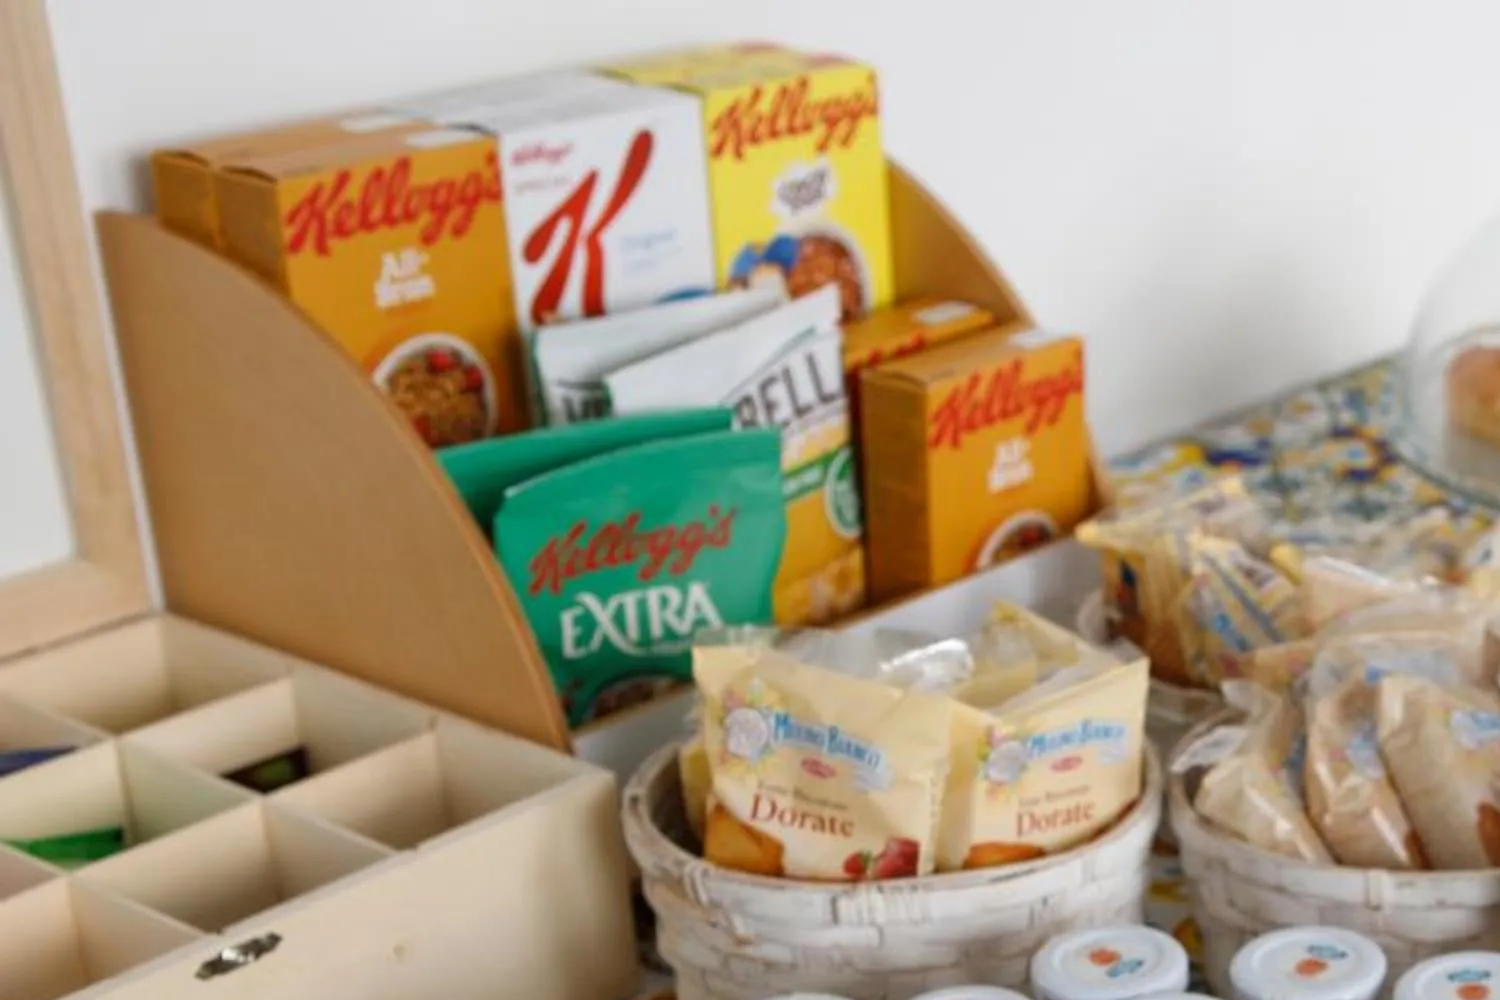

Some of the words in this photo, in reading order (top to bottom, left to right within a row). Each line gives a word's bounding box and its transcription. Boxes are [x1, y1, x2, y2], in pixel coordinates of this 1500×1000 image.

[523, 130, 653, 324] K
[529, 505, 738, 597] Kellogg's
[562, 583, 724, 659] EXTRA
[750, 794, 855, 838] Dorate
[1017, 801, 1096, 838] Dorate
